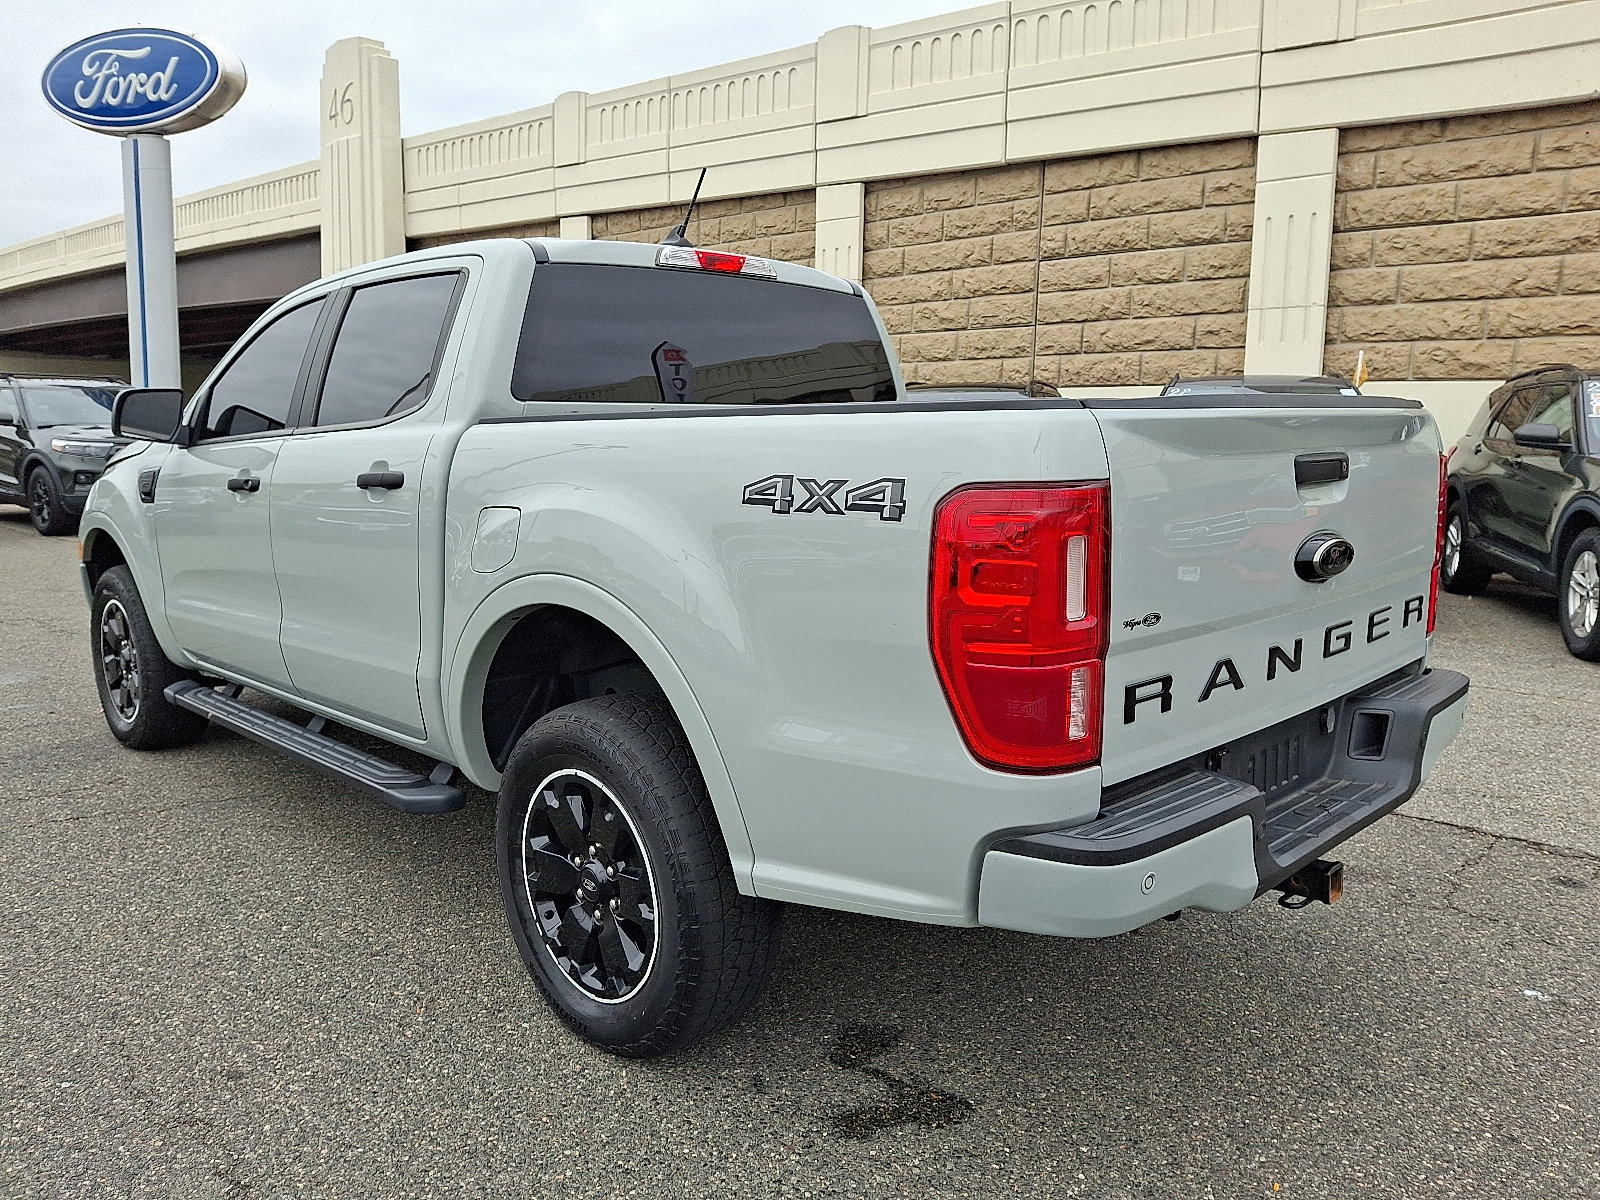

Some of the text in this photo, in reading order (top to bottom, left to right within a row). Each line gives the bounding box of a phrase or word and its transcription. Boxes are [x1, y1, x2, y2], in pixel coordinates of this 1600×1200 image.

[74, 46, 179, 108] Ford
[329, 81, 354, 128] 46
[1123, 595, 1424, 725] RANGER
